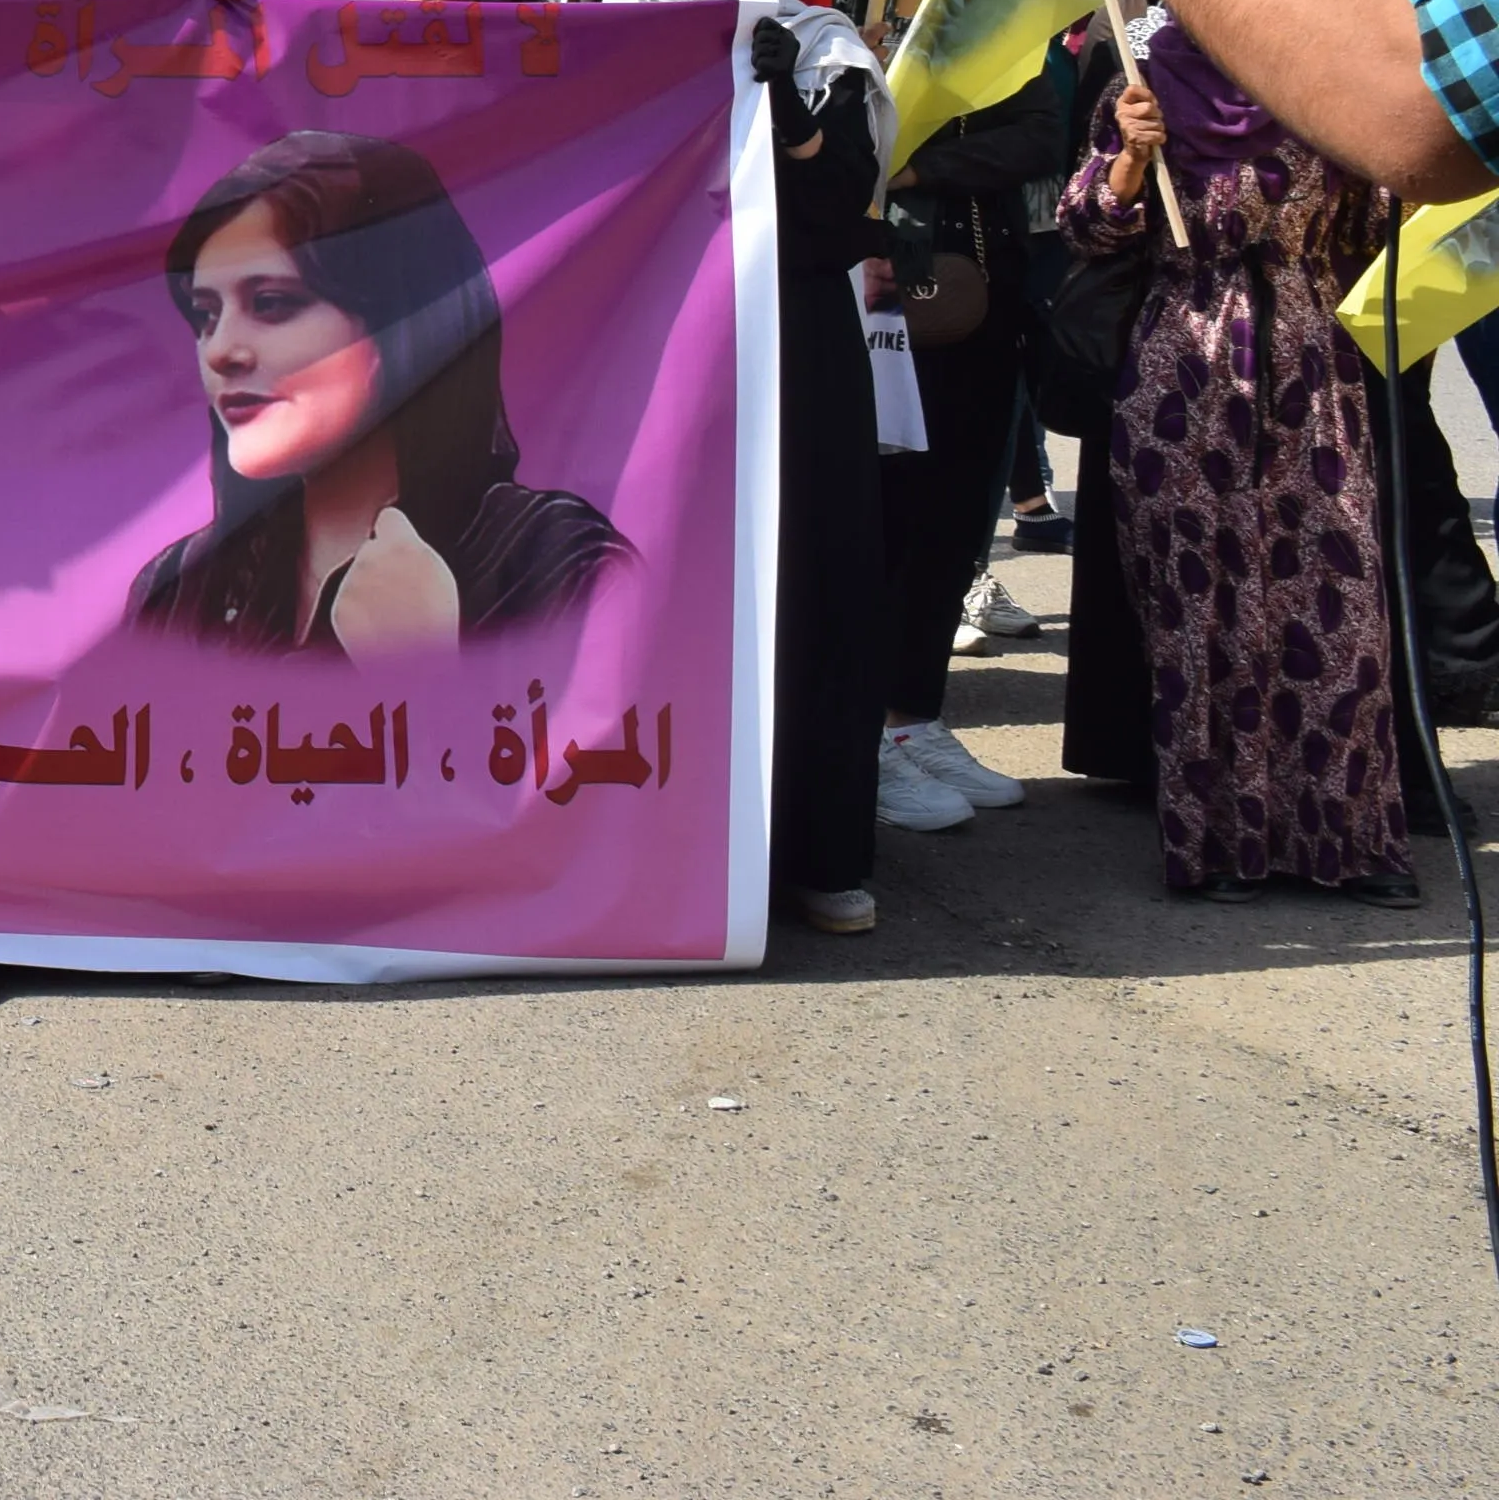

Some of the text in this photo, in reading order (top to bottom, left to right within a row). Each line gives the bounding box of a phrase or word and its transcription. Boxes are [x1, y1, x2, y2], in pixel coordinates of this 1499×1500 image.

[306, 0, 484, 97] لقتل
[516, 2, 561, 77] لا
[225, 700, 409, 806] الحياة
[488, 678, 672, 807] المرأة
